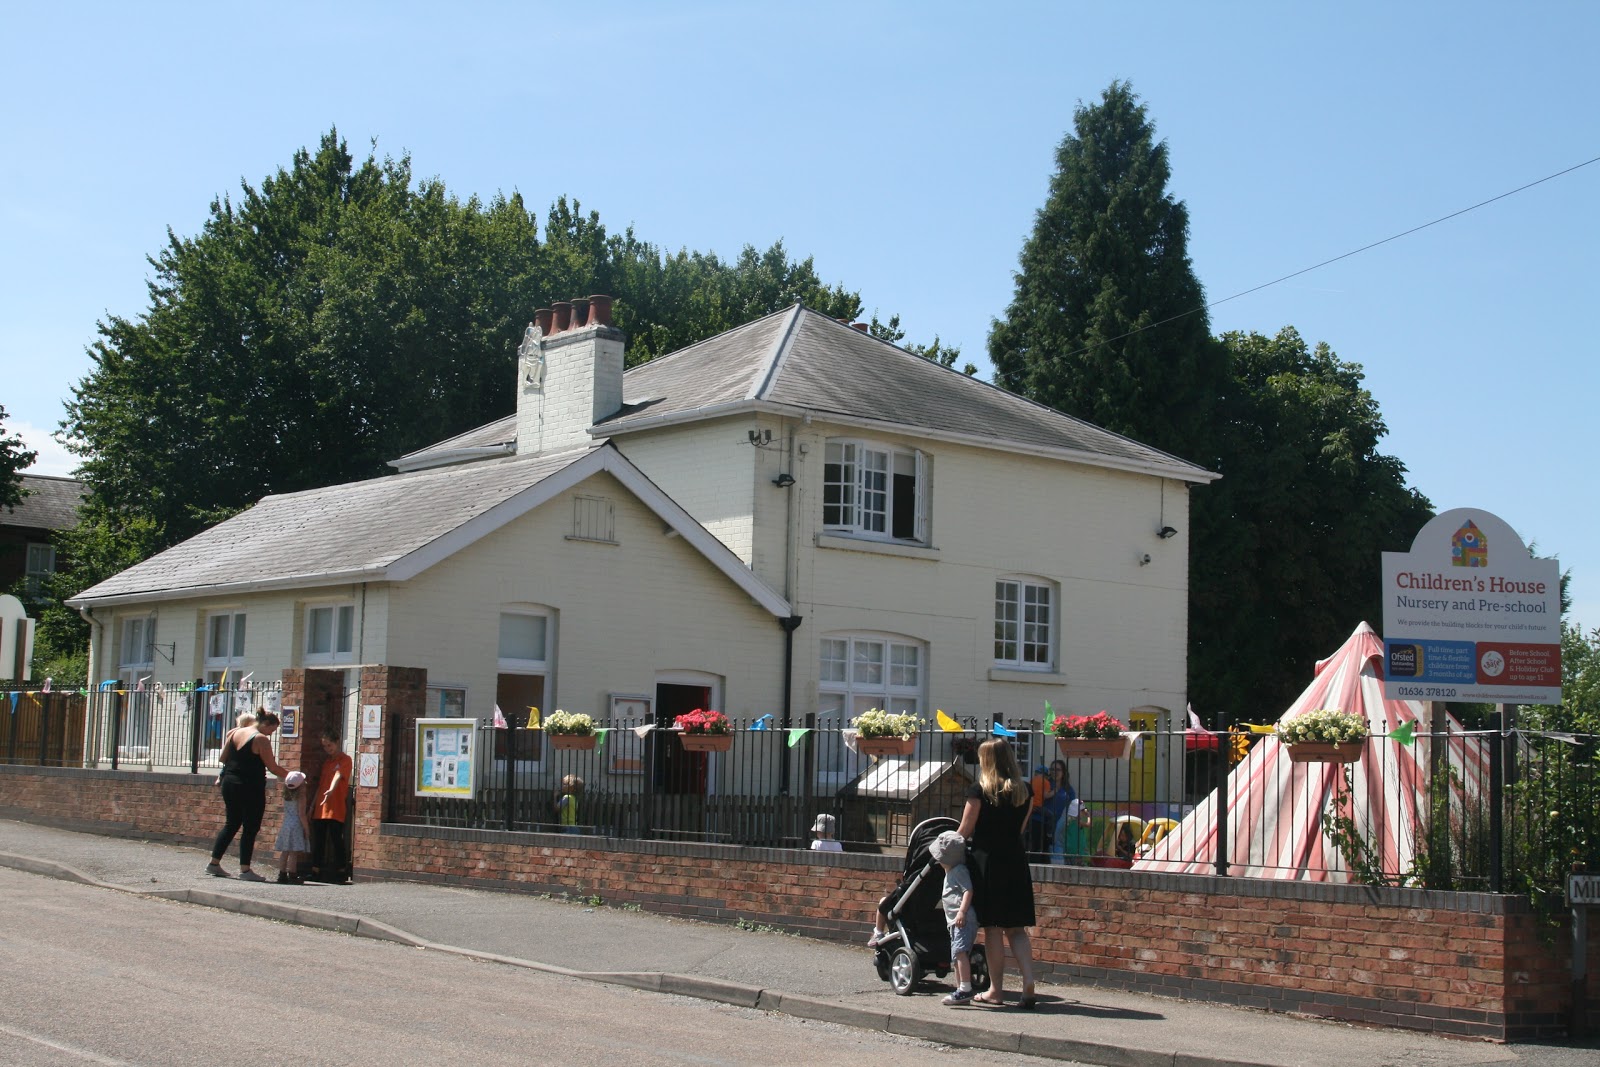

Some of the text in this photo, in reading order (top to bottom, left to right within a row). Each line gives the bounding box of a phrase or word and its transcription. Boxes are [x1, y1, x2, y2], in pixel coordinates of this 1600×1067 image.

[1396, 572, 1546, 594] Children's House
[1396, 595, 1546, 614] Nursery and Pre-school
[1397, 618, 1408, 626] We
[1408, 619, 1430, 627] provide
[1441, 620, 1465, 629] building
[1455, 647, 1468, 655] part
[1391, 652, 1414, 662] Ofsted
[1398, 686, 1457, 697] 01636 378120
